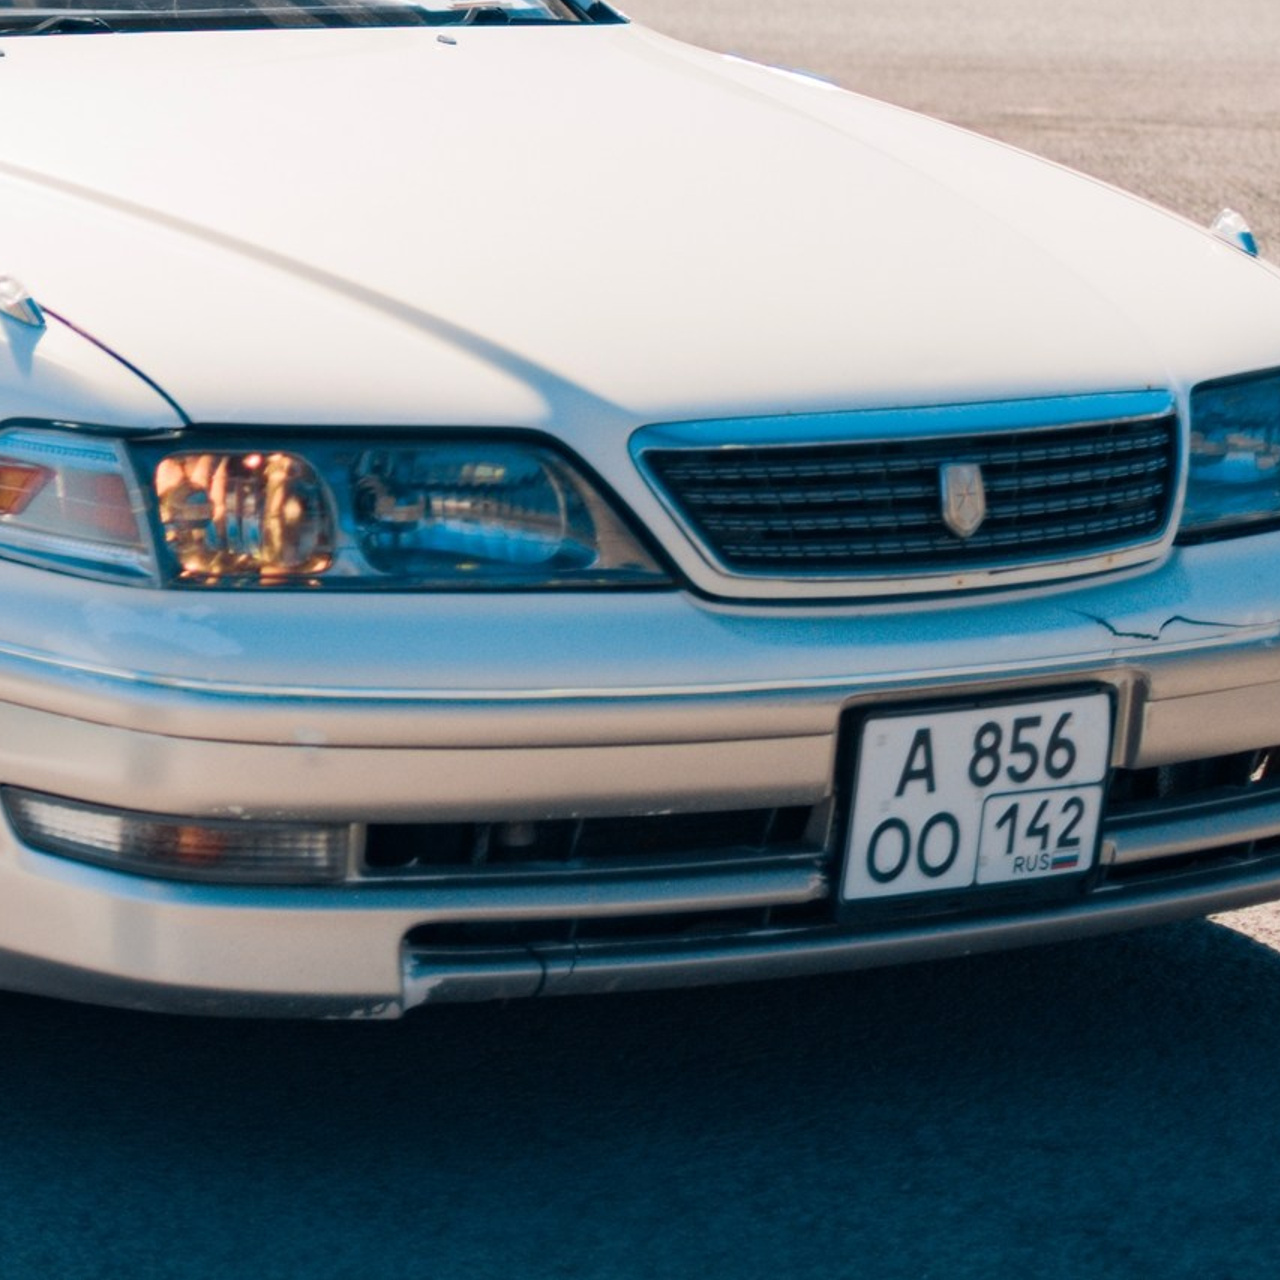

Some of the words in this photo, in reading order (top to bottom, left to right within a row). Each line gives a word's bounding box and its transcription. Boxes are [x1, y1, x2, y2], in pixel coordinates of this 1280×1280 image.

[968, 712, 1077, 787] 856
[995, 796, 1085, 855] 142
[1013, 853, 1050, 874] RUS
